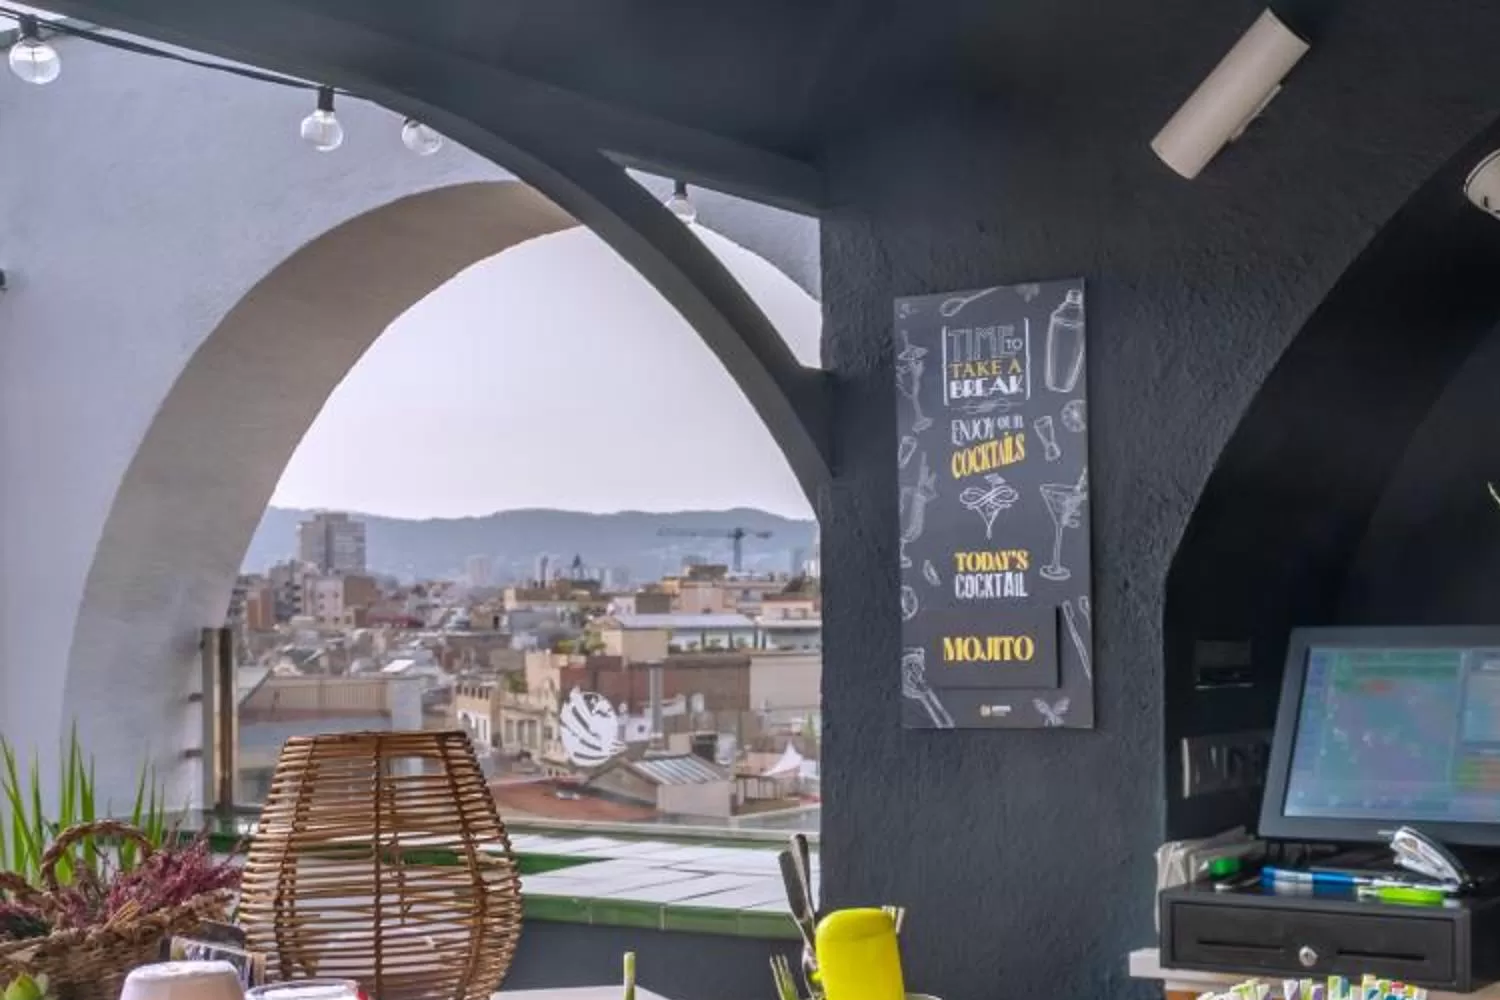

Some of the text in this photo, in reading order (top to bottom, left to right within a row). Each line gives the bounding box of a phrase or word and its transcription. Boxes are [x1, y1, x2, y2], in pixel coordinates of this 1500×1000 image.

[948, 325, 1023, 362] TIME TO
[949, 358, 1022, 378] TAKE A
[950, 374, 1024, 399] BREAK
[951, 416, 995, 447] ENJOY
[951, 432, 1025, 479] COCKTAILS
[954, 550, 1030, 573] TODAY'S
[954, 571, 1029, 599] COCKTAIL
[943, 635, 1034, 661] MOJITO
